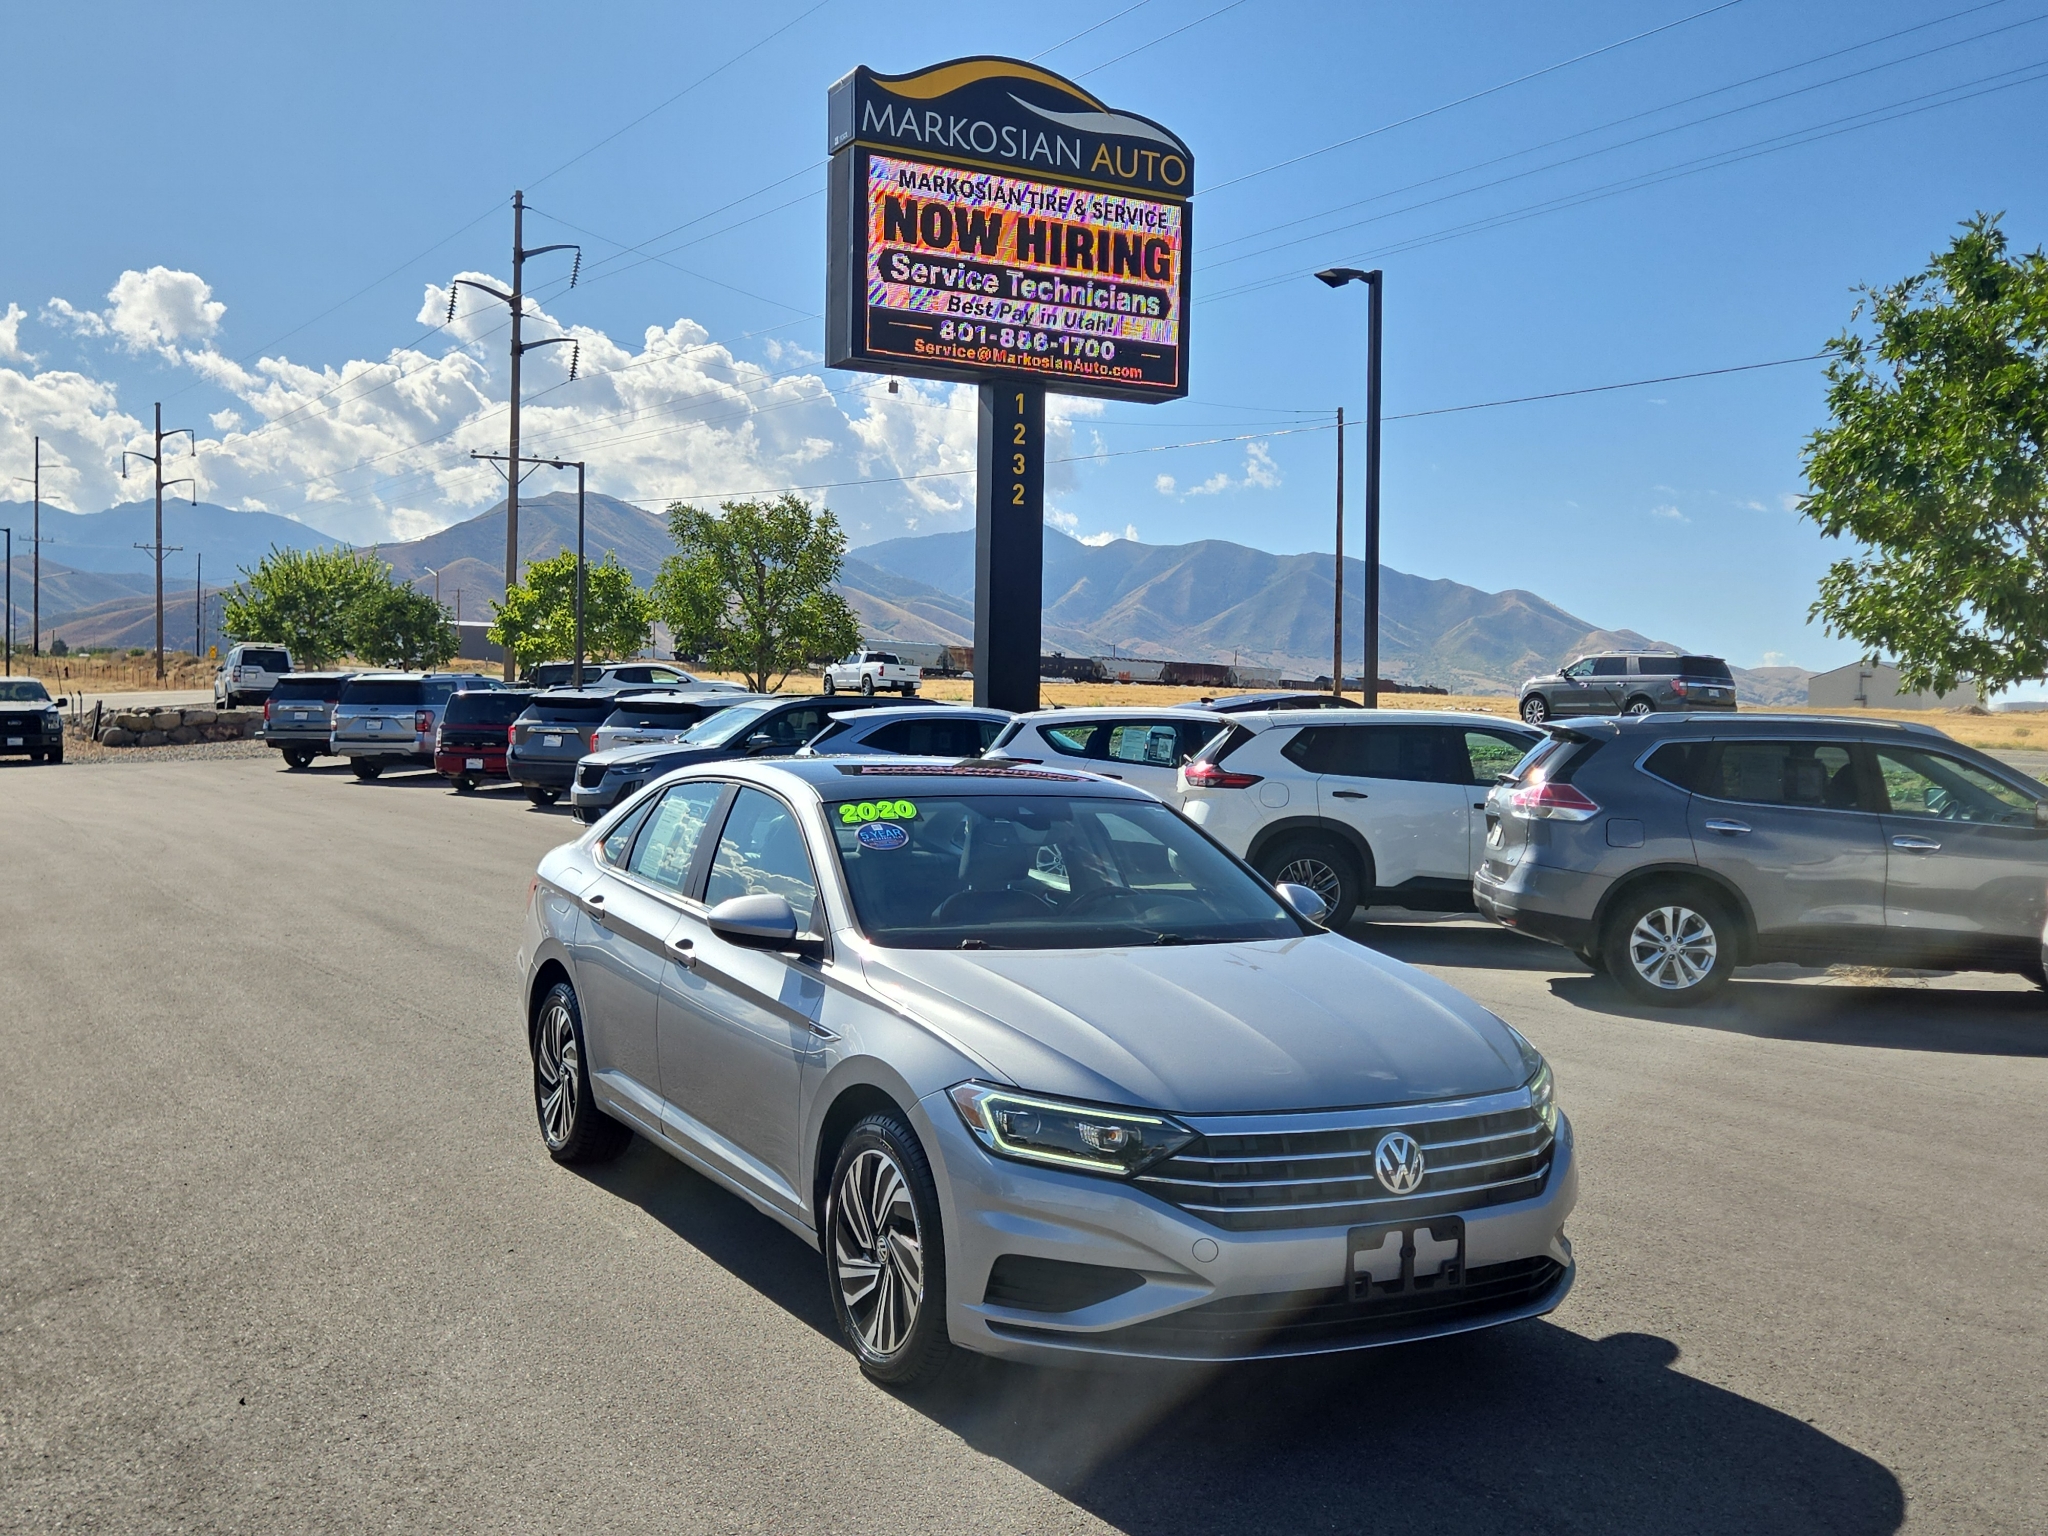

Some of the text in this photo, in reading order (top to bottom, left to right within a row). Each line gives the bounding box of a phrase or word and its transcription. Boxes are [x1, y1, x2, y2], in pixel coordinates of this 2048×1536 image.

[862, 100, 1187, 186] MARKOSIAN AUTO
[899, 169, 1168, 229] MARKOSIAN TIRE & SERVICE
[884, 194, 1171, 282] NOW HIRING
[890, 252, 1161, 316] Service Technicians
[947, 296, 1114, 332] Best Pay in Utah!
[914, 338, 1143, 379] Service@MarkosianAuto.com
[839, 800, 917, 824] 2020
[859, 831, 870, 840] 5
[870, 828, 903, 839] YEAR
